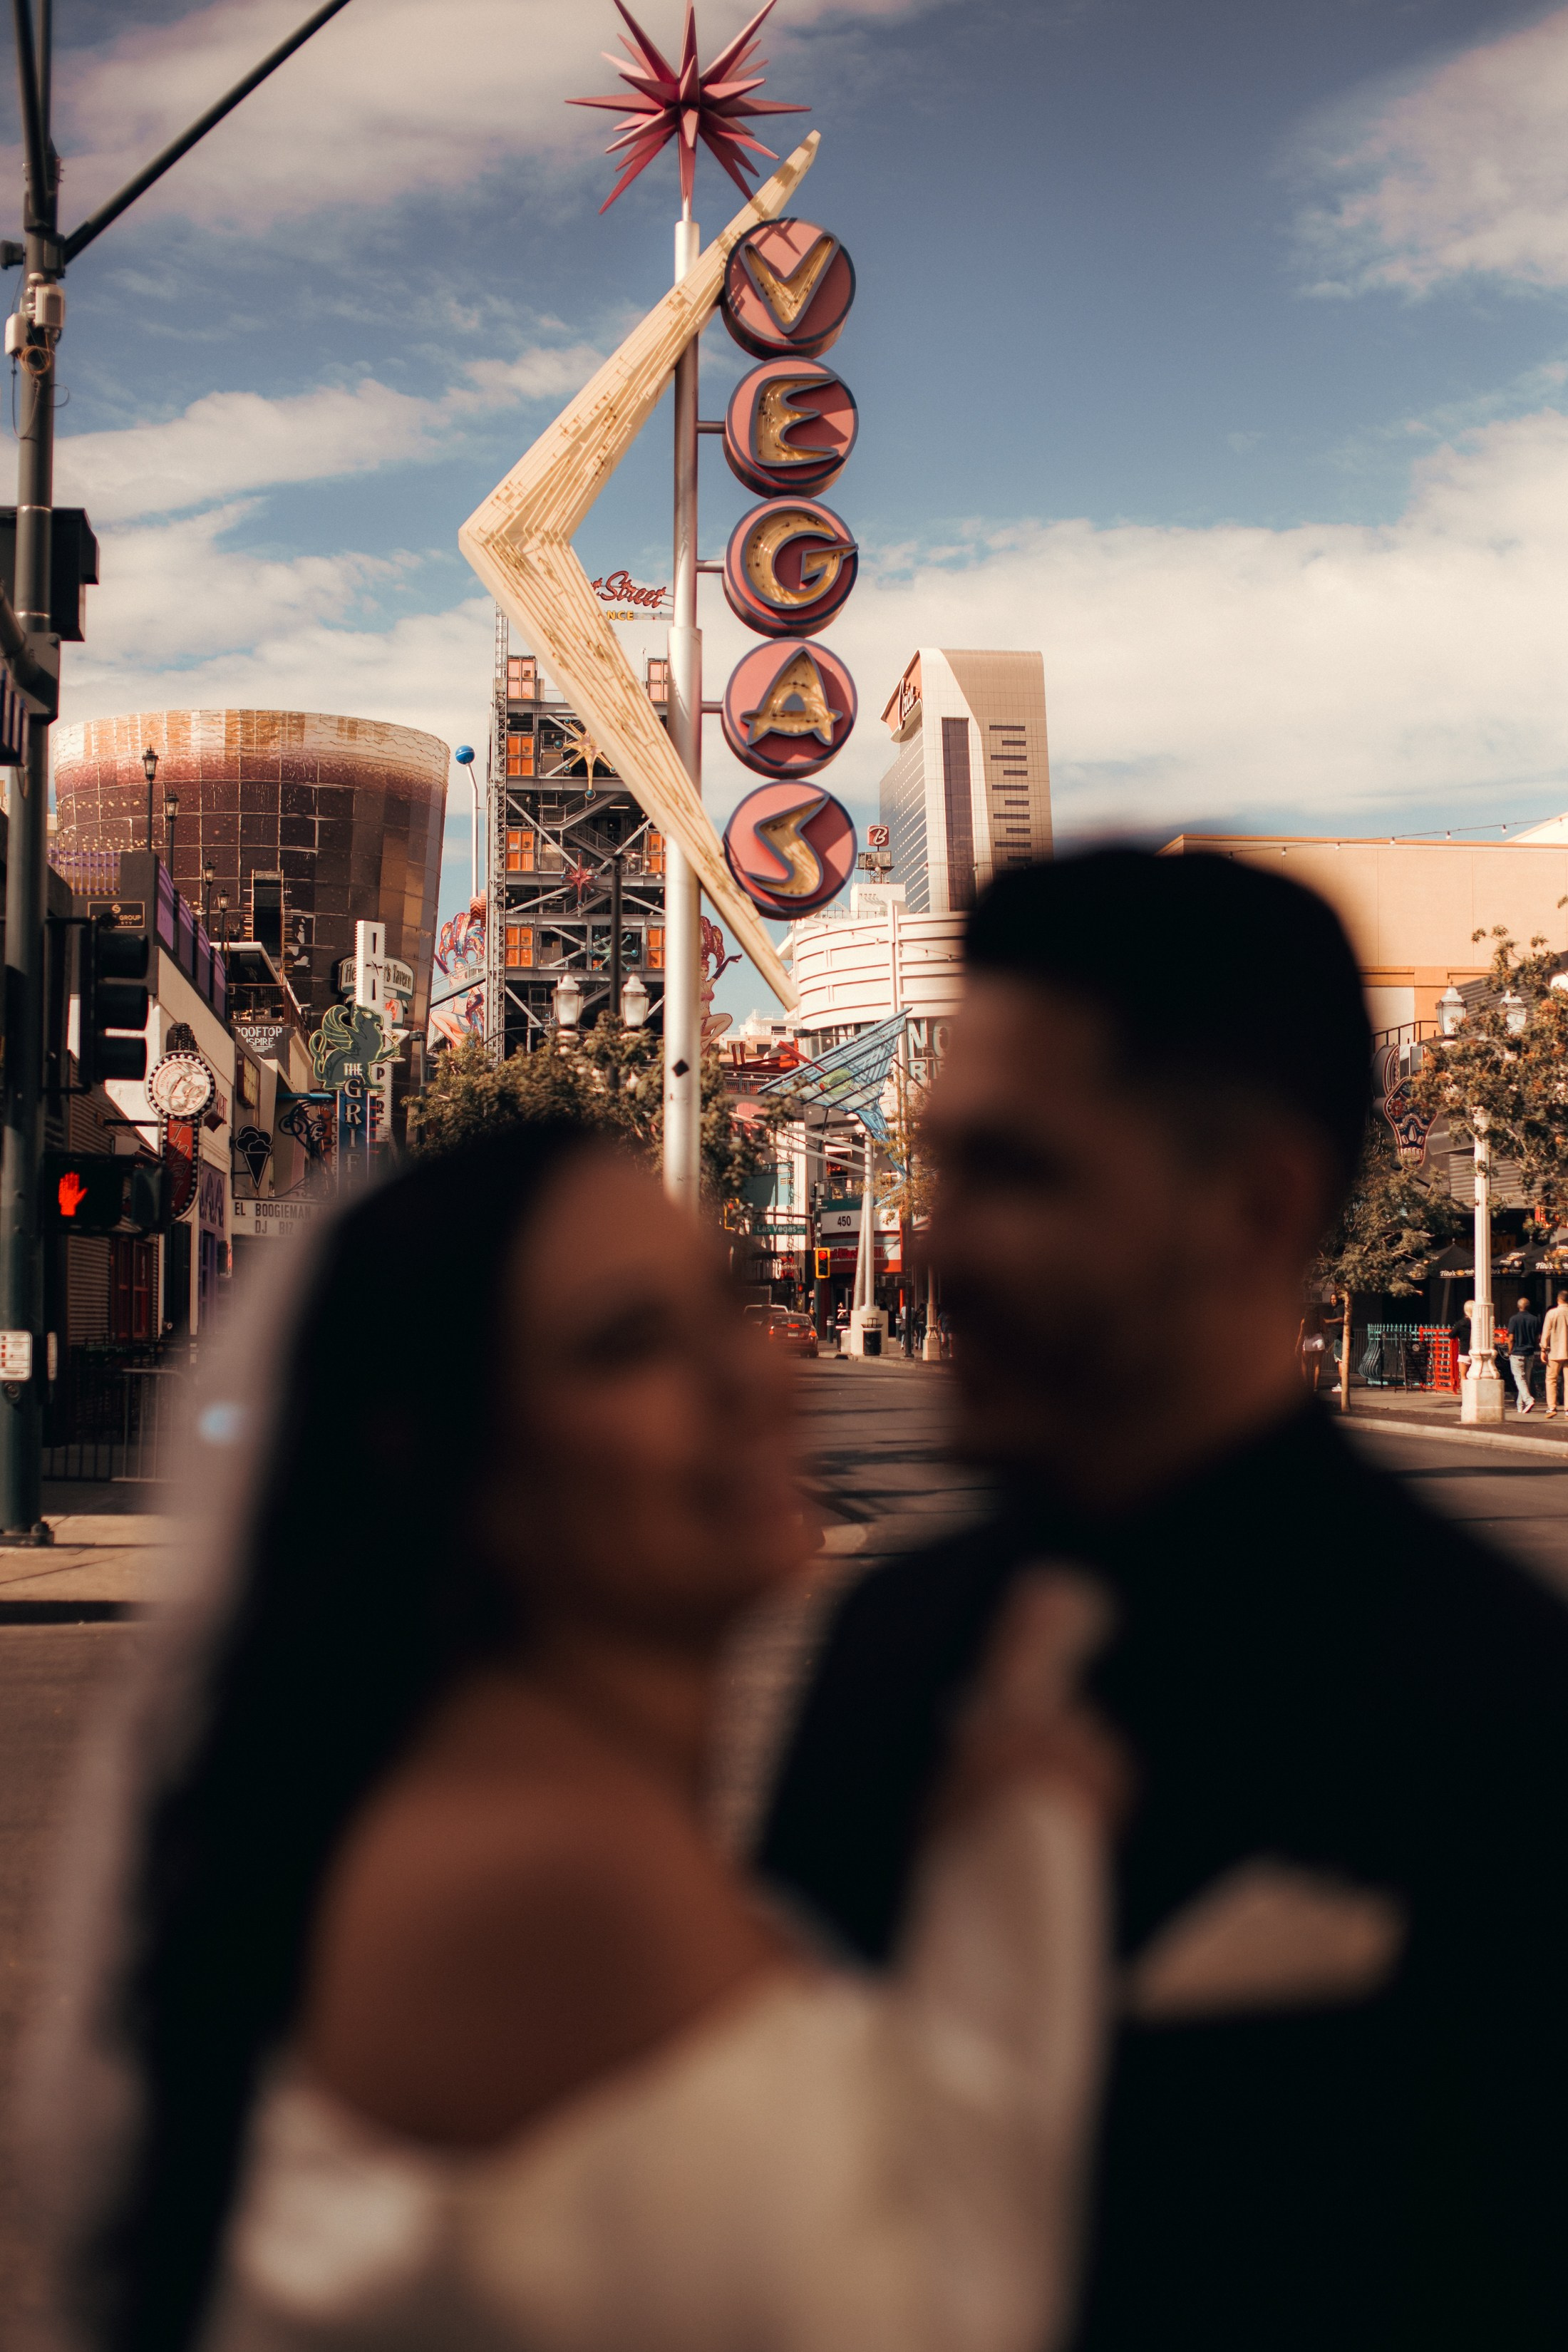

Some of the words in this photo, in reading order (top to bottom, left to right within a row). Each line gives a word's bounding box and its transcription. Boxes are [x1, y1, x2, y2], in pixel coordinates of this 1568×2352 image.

[740, 234, 860, 897] VEGAS
[600, 570, 666, 609] Street
[869, 827, 888, 845] B
[392, 964, 412, 990] Tavern
[246, 1037, 276, 1046] SPIRE
[344, 1063, 363, 1076] THE
[234, 1202, 246, 1216] EL
[255, 1202, 311, 1220] BOOGIEMAN
[255, 1219, 267, 1234] DJ
[773, 1224, 796, 1234] Vegas
[837, 1215, 852, 1227] 450
